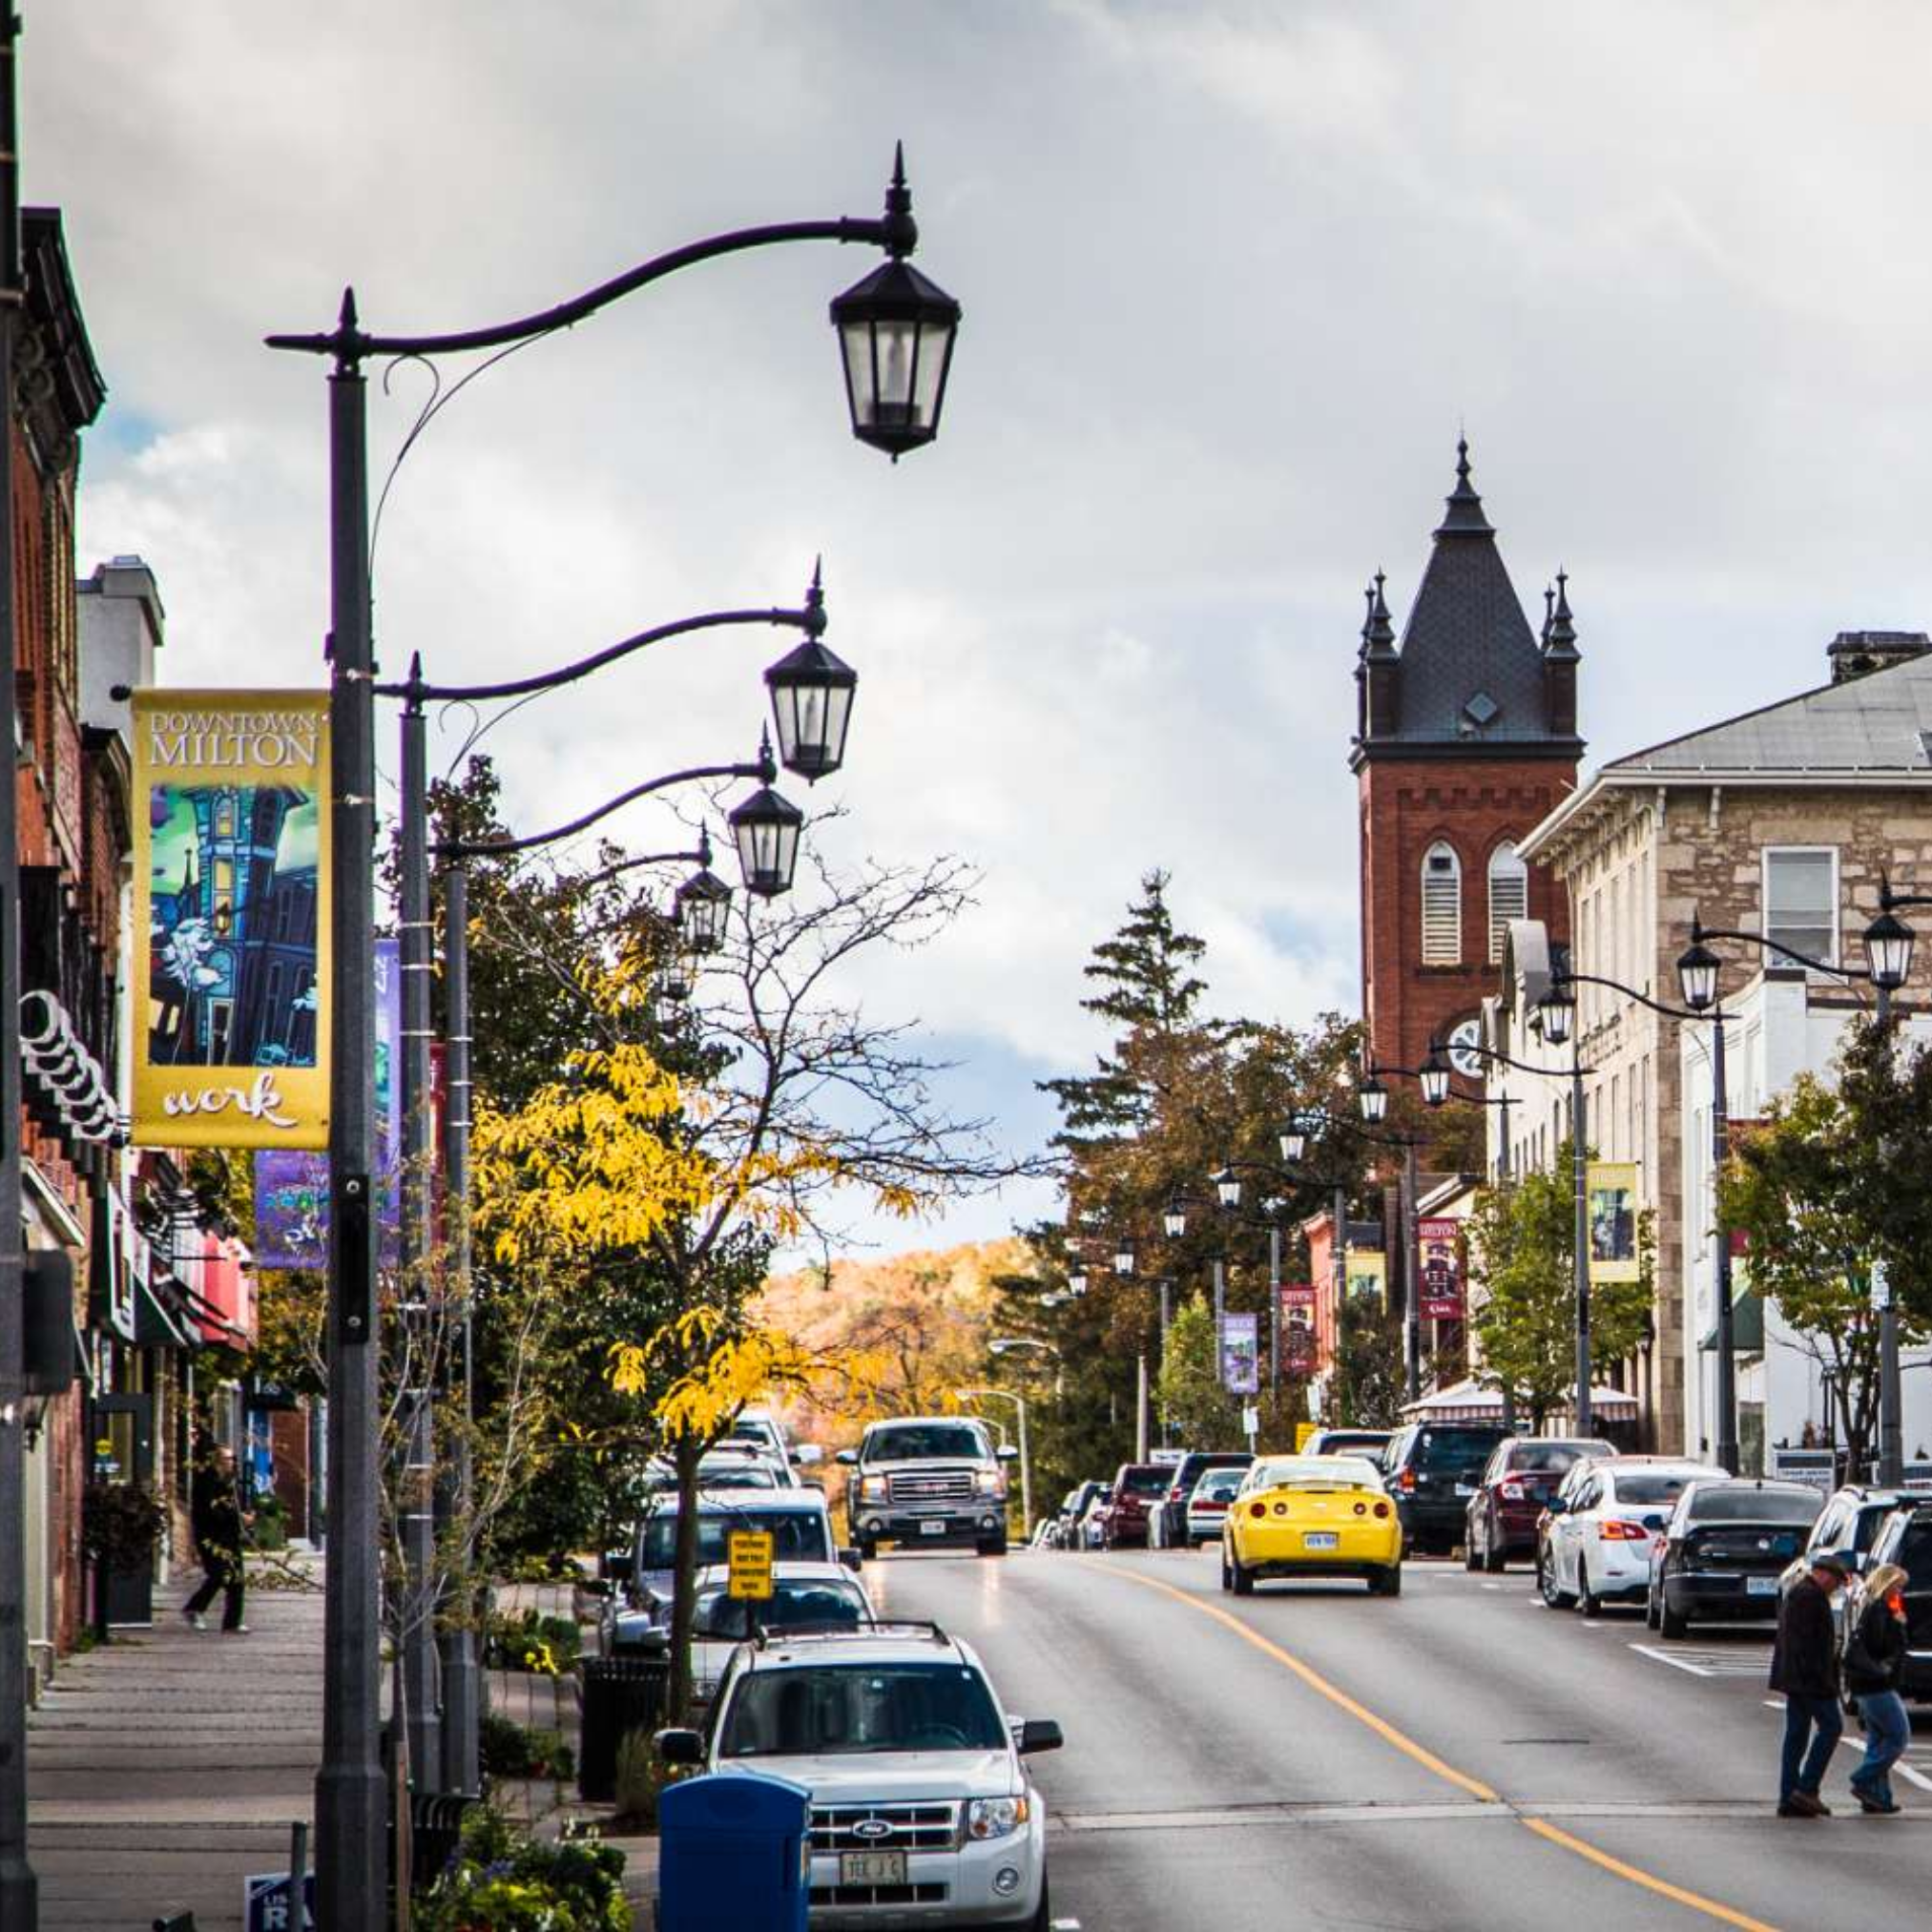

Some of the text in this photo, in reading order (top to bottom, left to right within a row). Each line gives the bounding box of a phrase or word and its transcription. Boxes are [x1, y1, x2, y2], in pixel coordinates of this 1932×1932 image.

[151, 712, 318, 734] DOWNTOWN
[151, 733, 320, 767] MILTON
[163, 1070, 299, 1127] work
